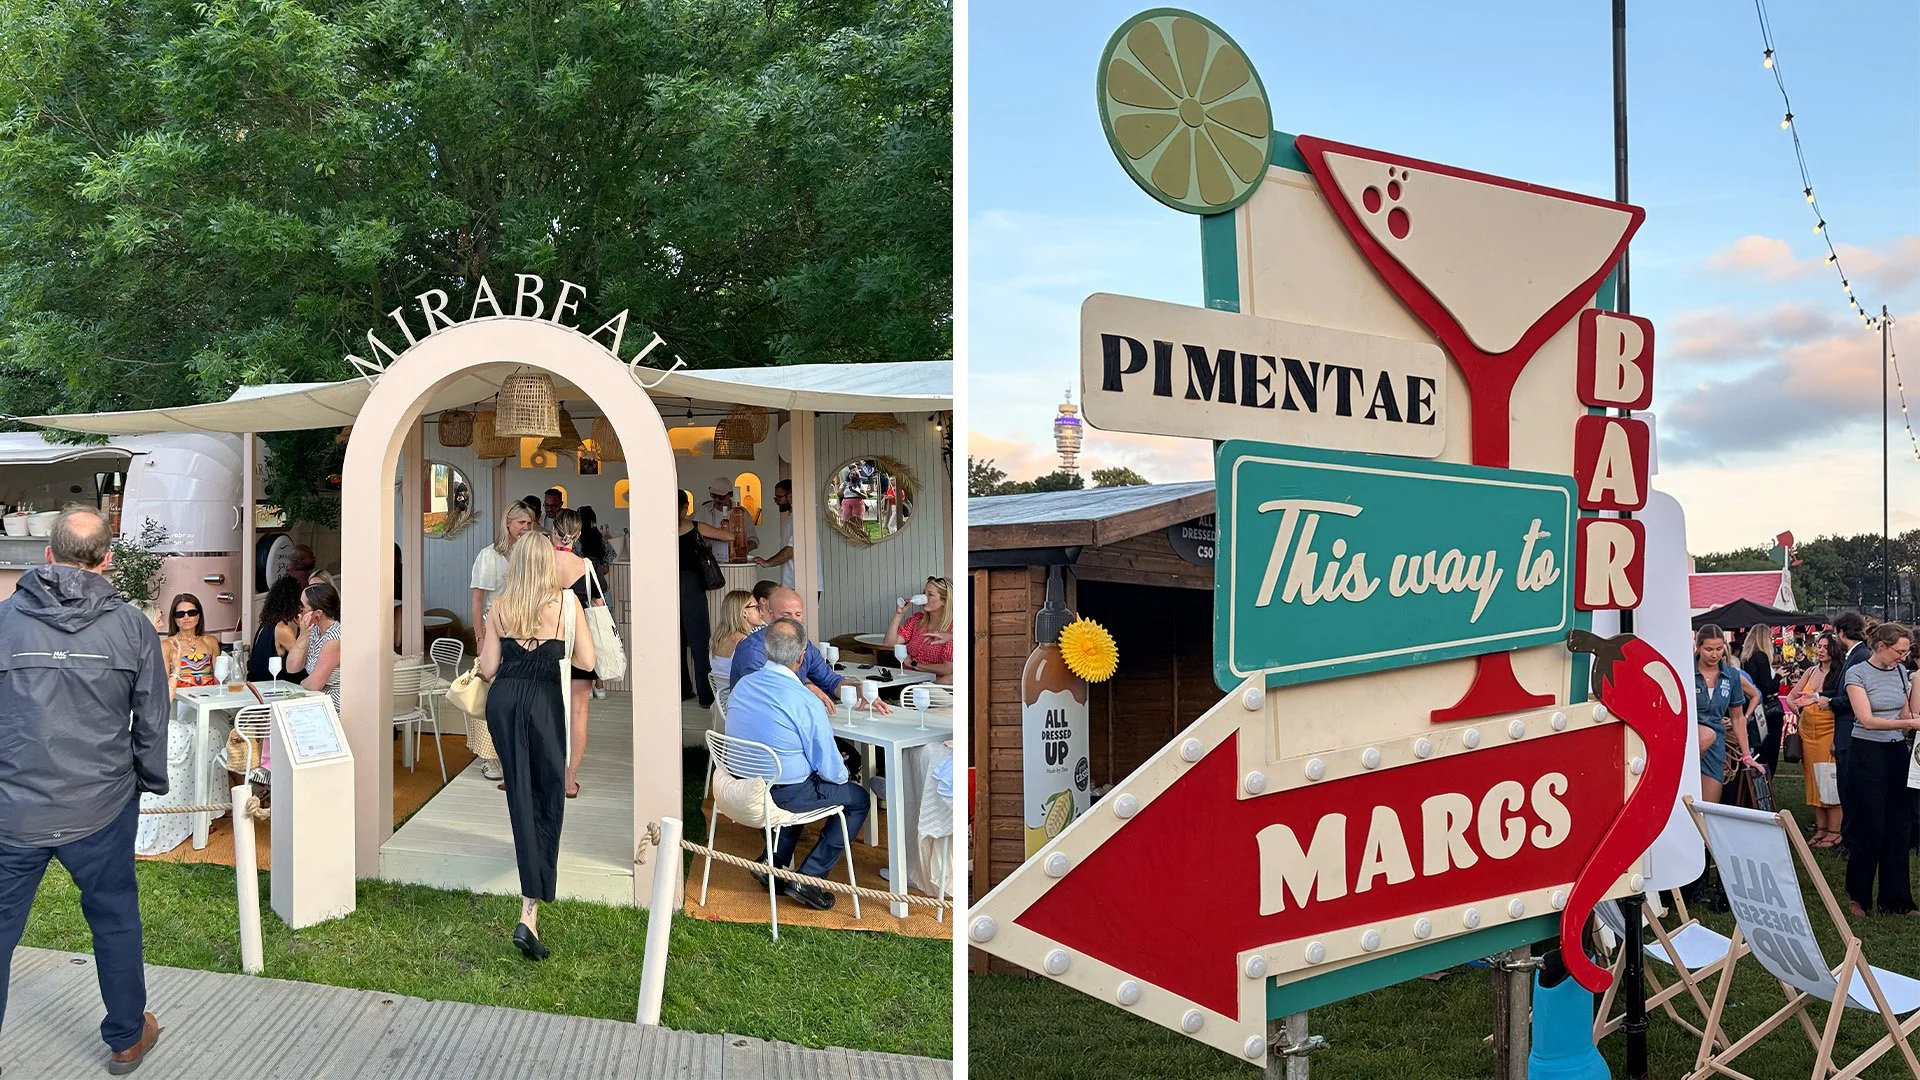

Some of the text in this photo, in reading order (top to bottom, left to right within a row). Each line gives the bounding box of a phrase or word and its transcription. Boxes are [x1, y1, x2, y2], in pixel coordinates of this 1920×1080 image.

[344, 273, 687, 391] MIRABEAU
[1100, 333, 1436, 425] PIMENTAE
[1584, 314, 1644, 607] BAR
[1199, 516, 1213, 527] ALL
[1197, 545, 1214, 559] C50
[1255, 499, 1560, 624] This way to
[1042, 729, 1071, 740] DRESSED
[1045, 709, 1068, 728] ALL
[1045, 741, 1068, 765] UP
[1255, 772, 1571, 916] MARGS
